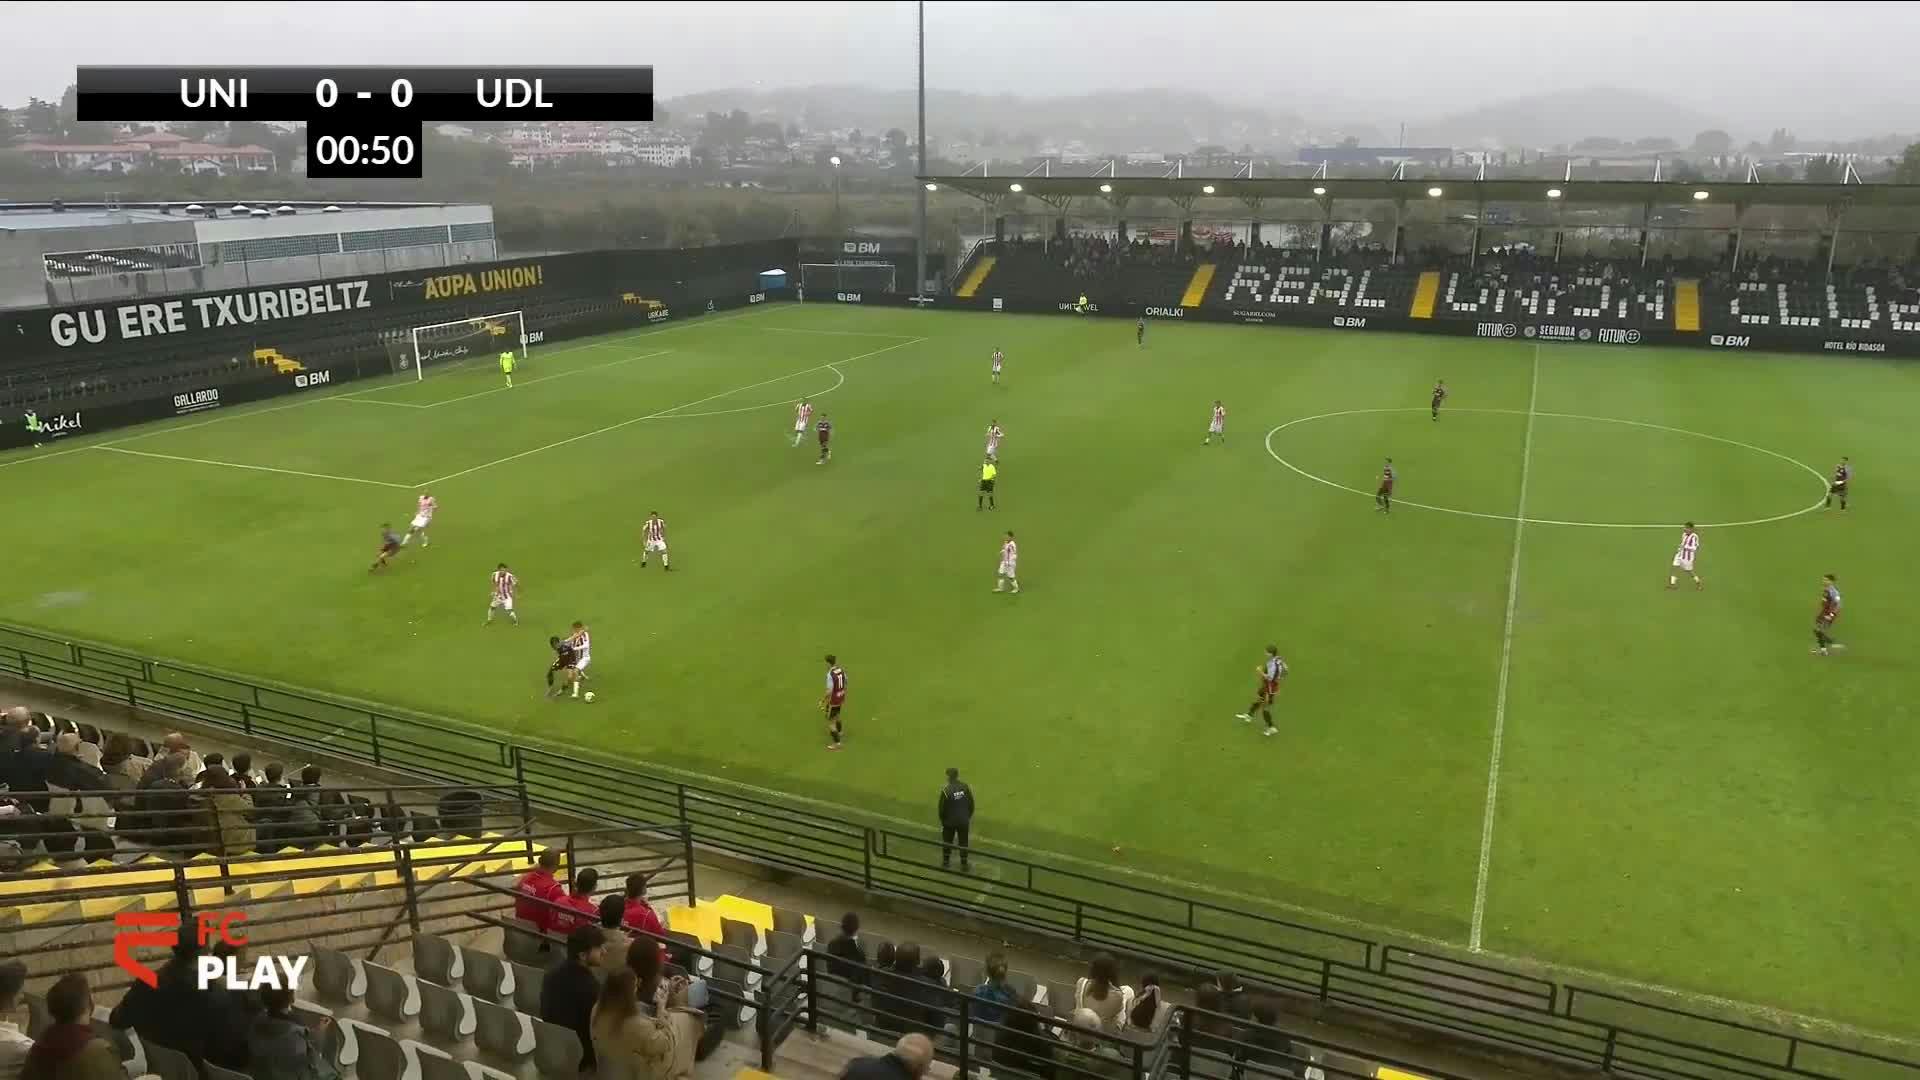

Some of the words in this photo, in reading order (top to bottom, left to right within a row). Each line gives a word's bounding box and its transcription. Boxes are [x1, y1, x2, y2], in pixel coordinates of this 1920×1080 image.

[858, 242, 881, 254] BM
[425, 274, 477, 300] AUPA
[481, 264, 543, 291] UNION!
[846, 293, 861, 302] BM
[50, 310, 106, 347] GU
[119, 301, 186, 339] ERE
[192, 281, 371, 329] TXURIBELTZ
[1145, 307, 1184, 317] ORIALKI
[1345, 316, 1366, 328] BM
[529, 331, 544, 343] BM
[1540, 325, 1576, 337] SEGUNDA
[1725, 336, 1750, 347] BM
[310, 371, 330, 385] BM
[174, 388, 219, 407] GALLARDO
